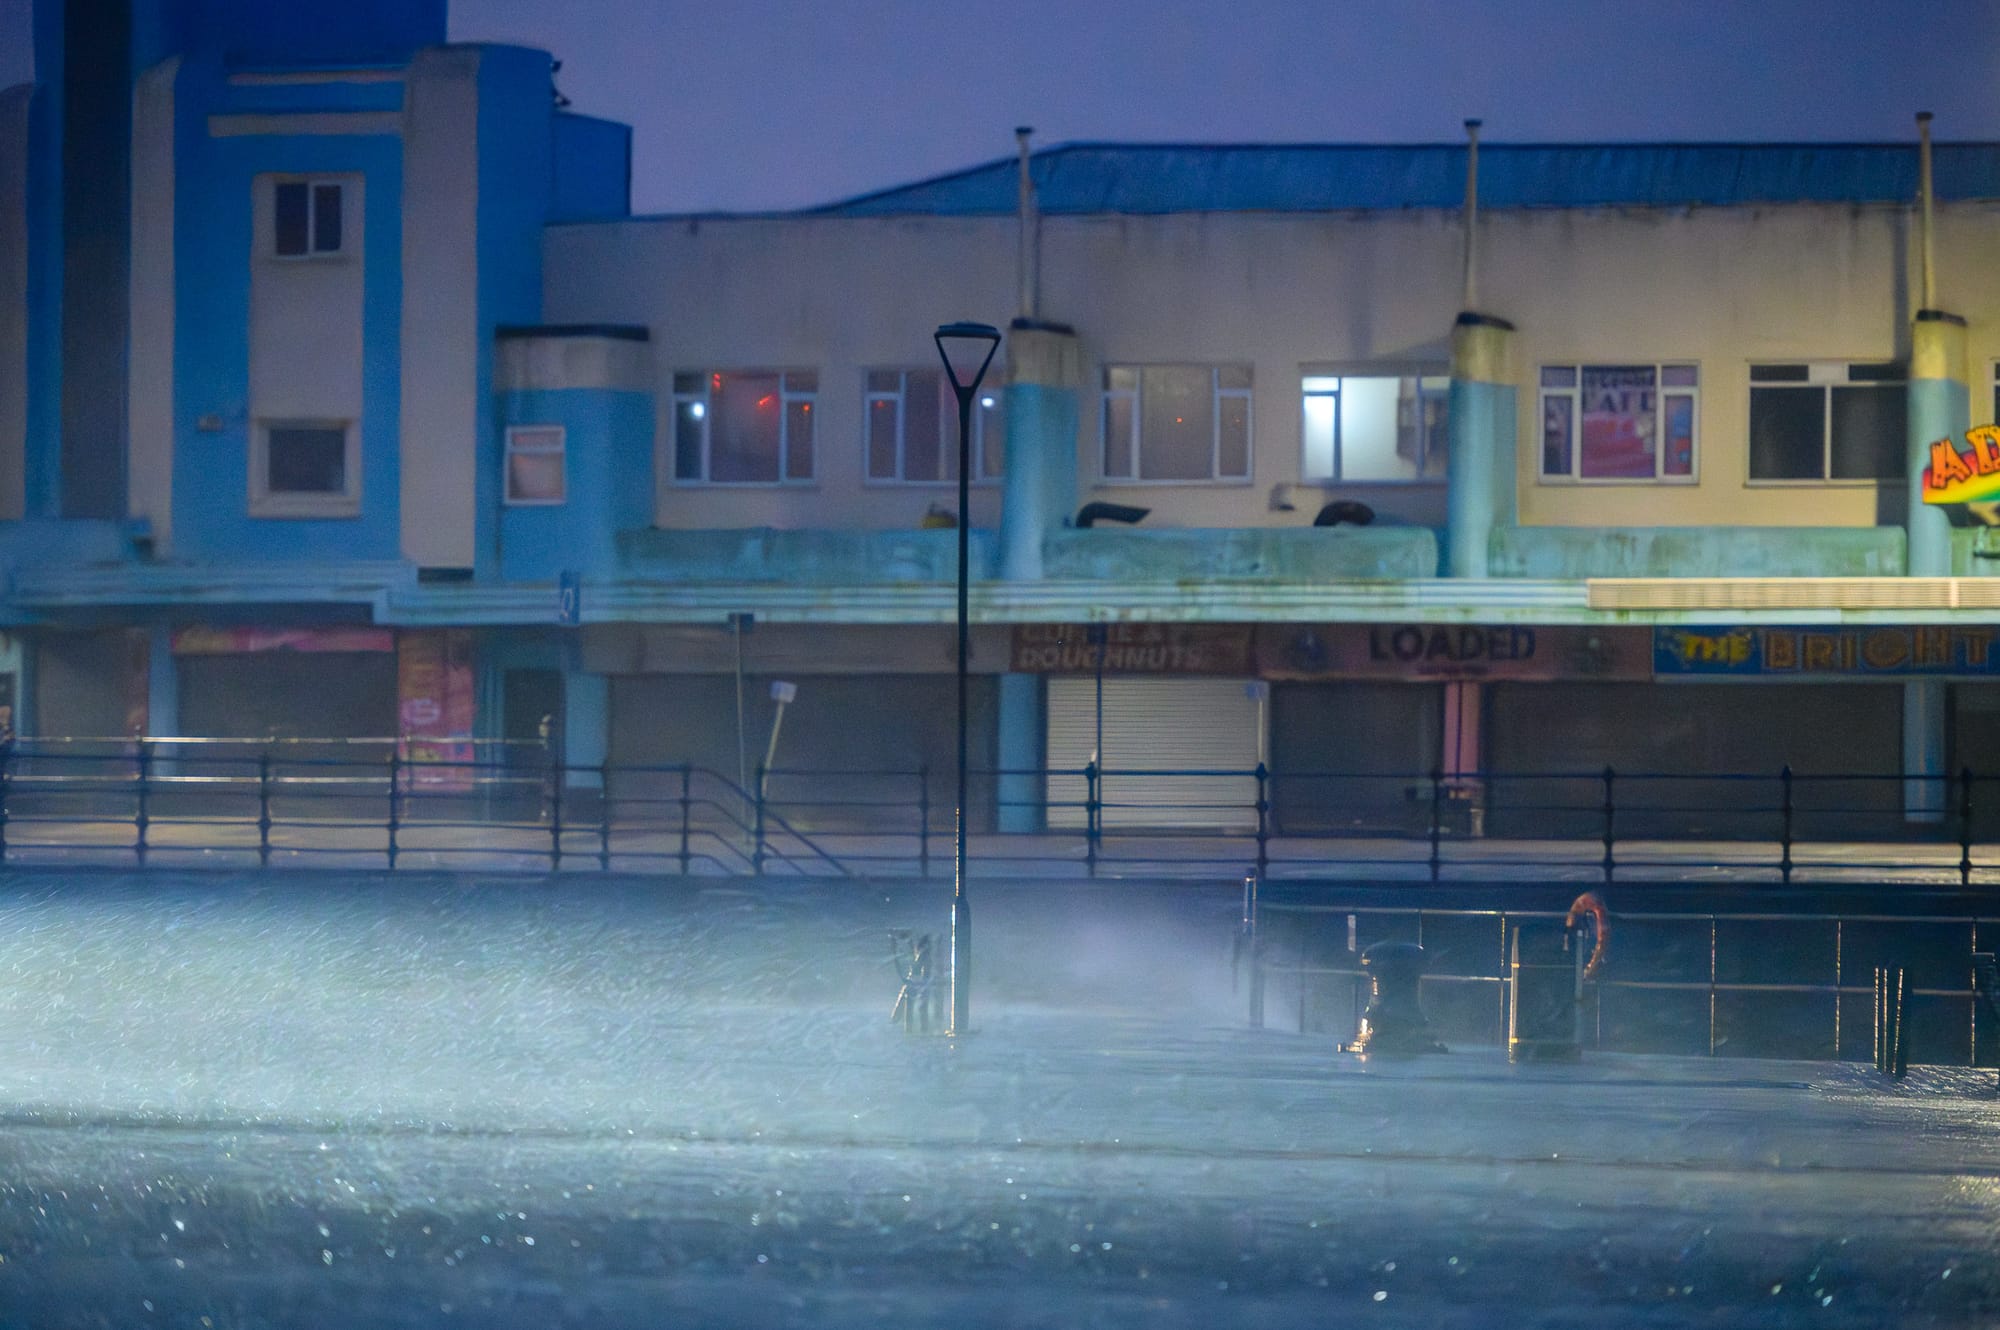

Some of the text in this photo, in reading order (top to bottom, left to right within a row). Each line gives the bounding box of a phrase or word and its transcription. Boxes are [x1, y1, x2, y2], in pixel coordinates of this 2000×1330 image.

[1369, 624, 1536, 661] LOADED
[1681, 625, 1995, 669] THE BRIGHT
